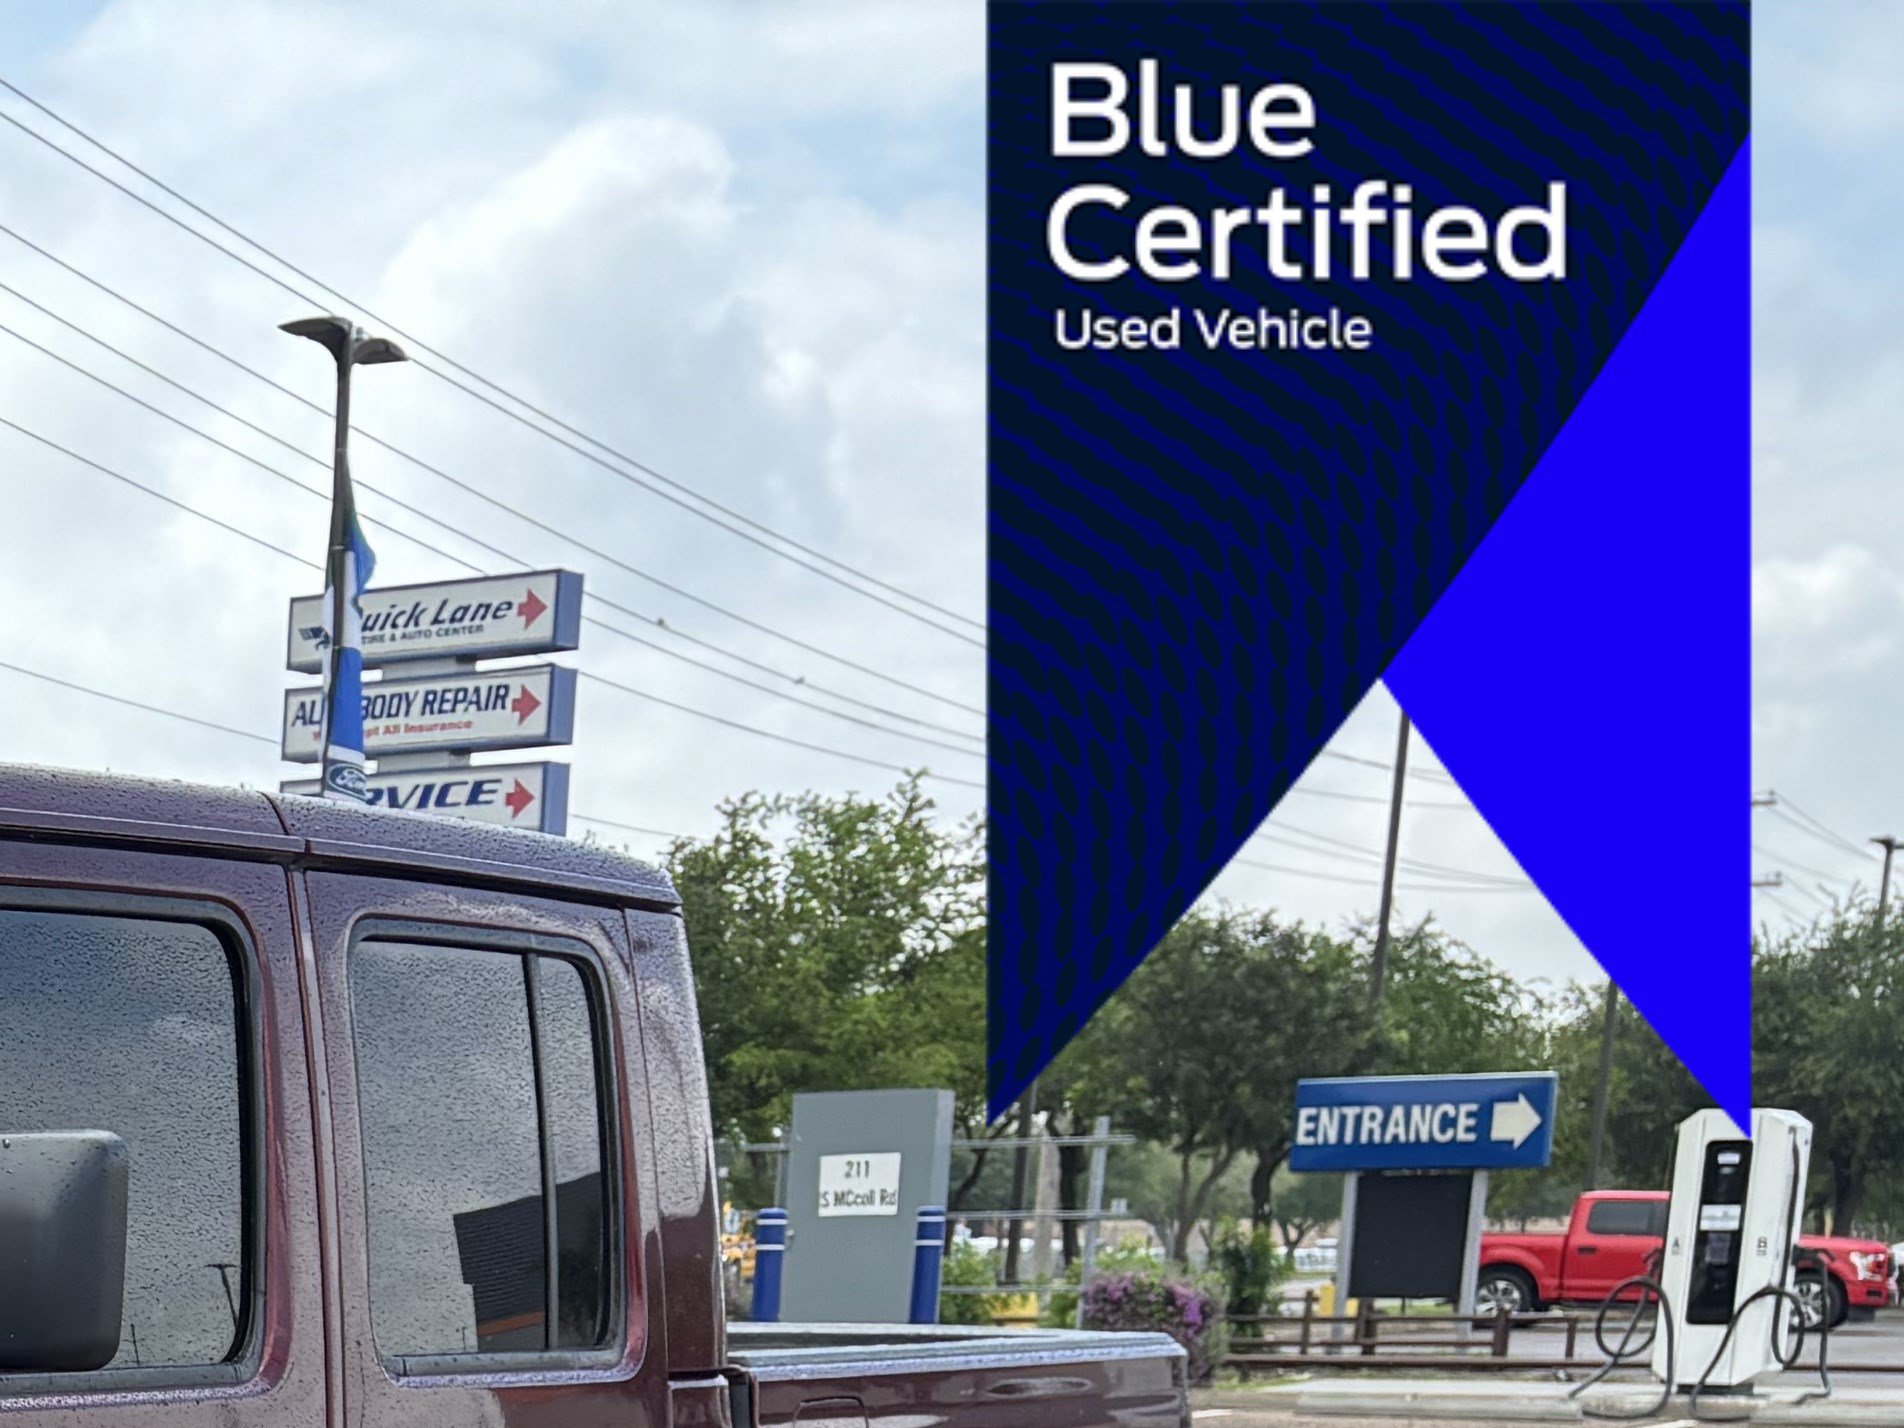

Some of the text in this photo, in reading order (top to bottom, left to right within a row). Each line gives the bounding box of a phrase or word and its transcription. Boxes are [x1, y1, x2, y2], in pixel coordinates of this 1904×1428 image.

[360, 597, 514, 632] uick Lane
[400, 628, 433, 641] AUTO
[435, 624, 485, 638] CENTER
[420, 683, 511, 717] REPAIR
[1295, 1102, 1481, 1146] ENTRANCE
[844, 1160, 870, 1178] 211
